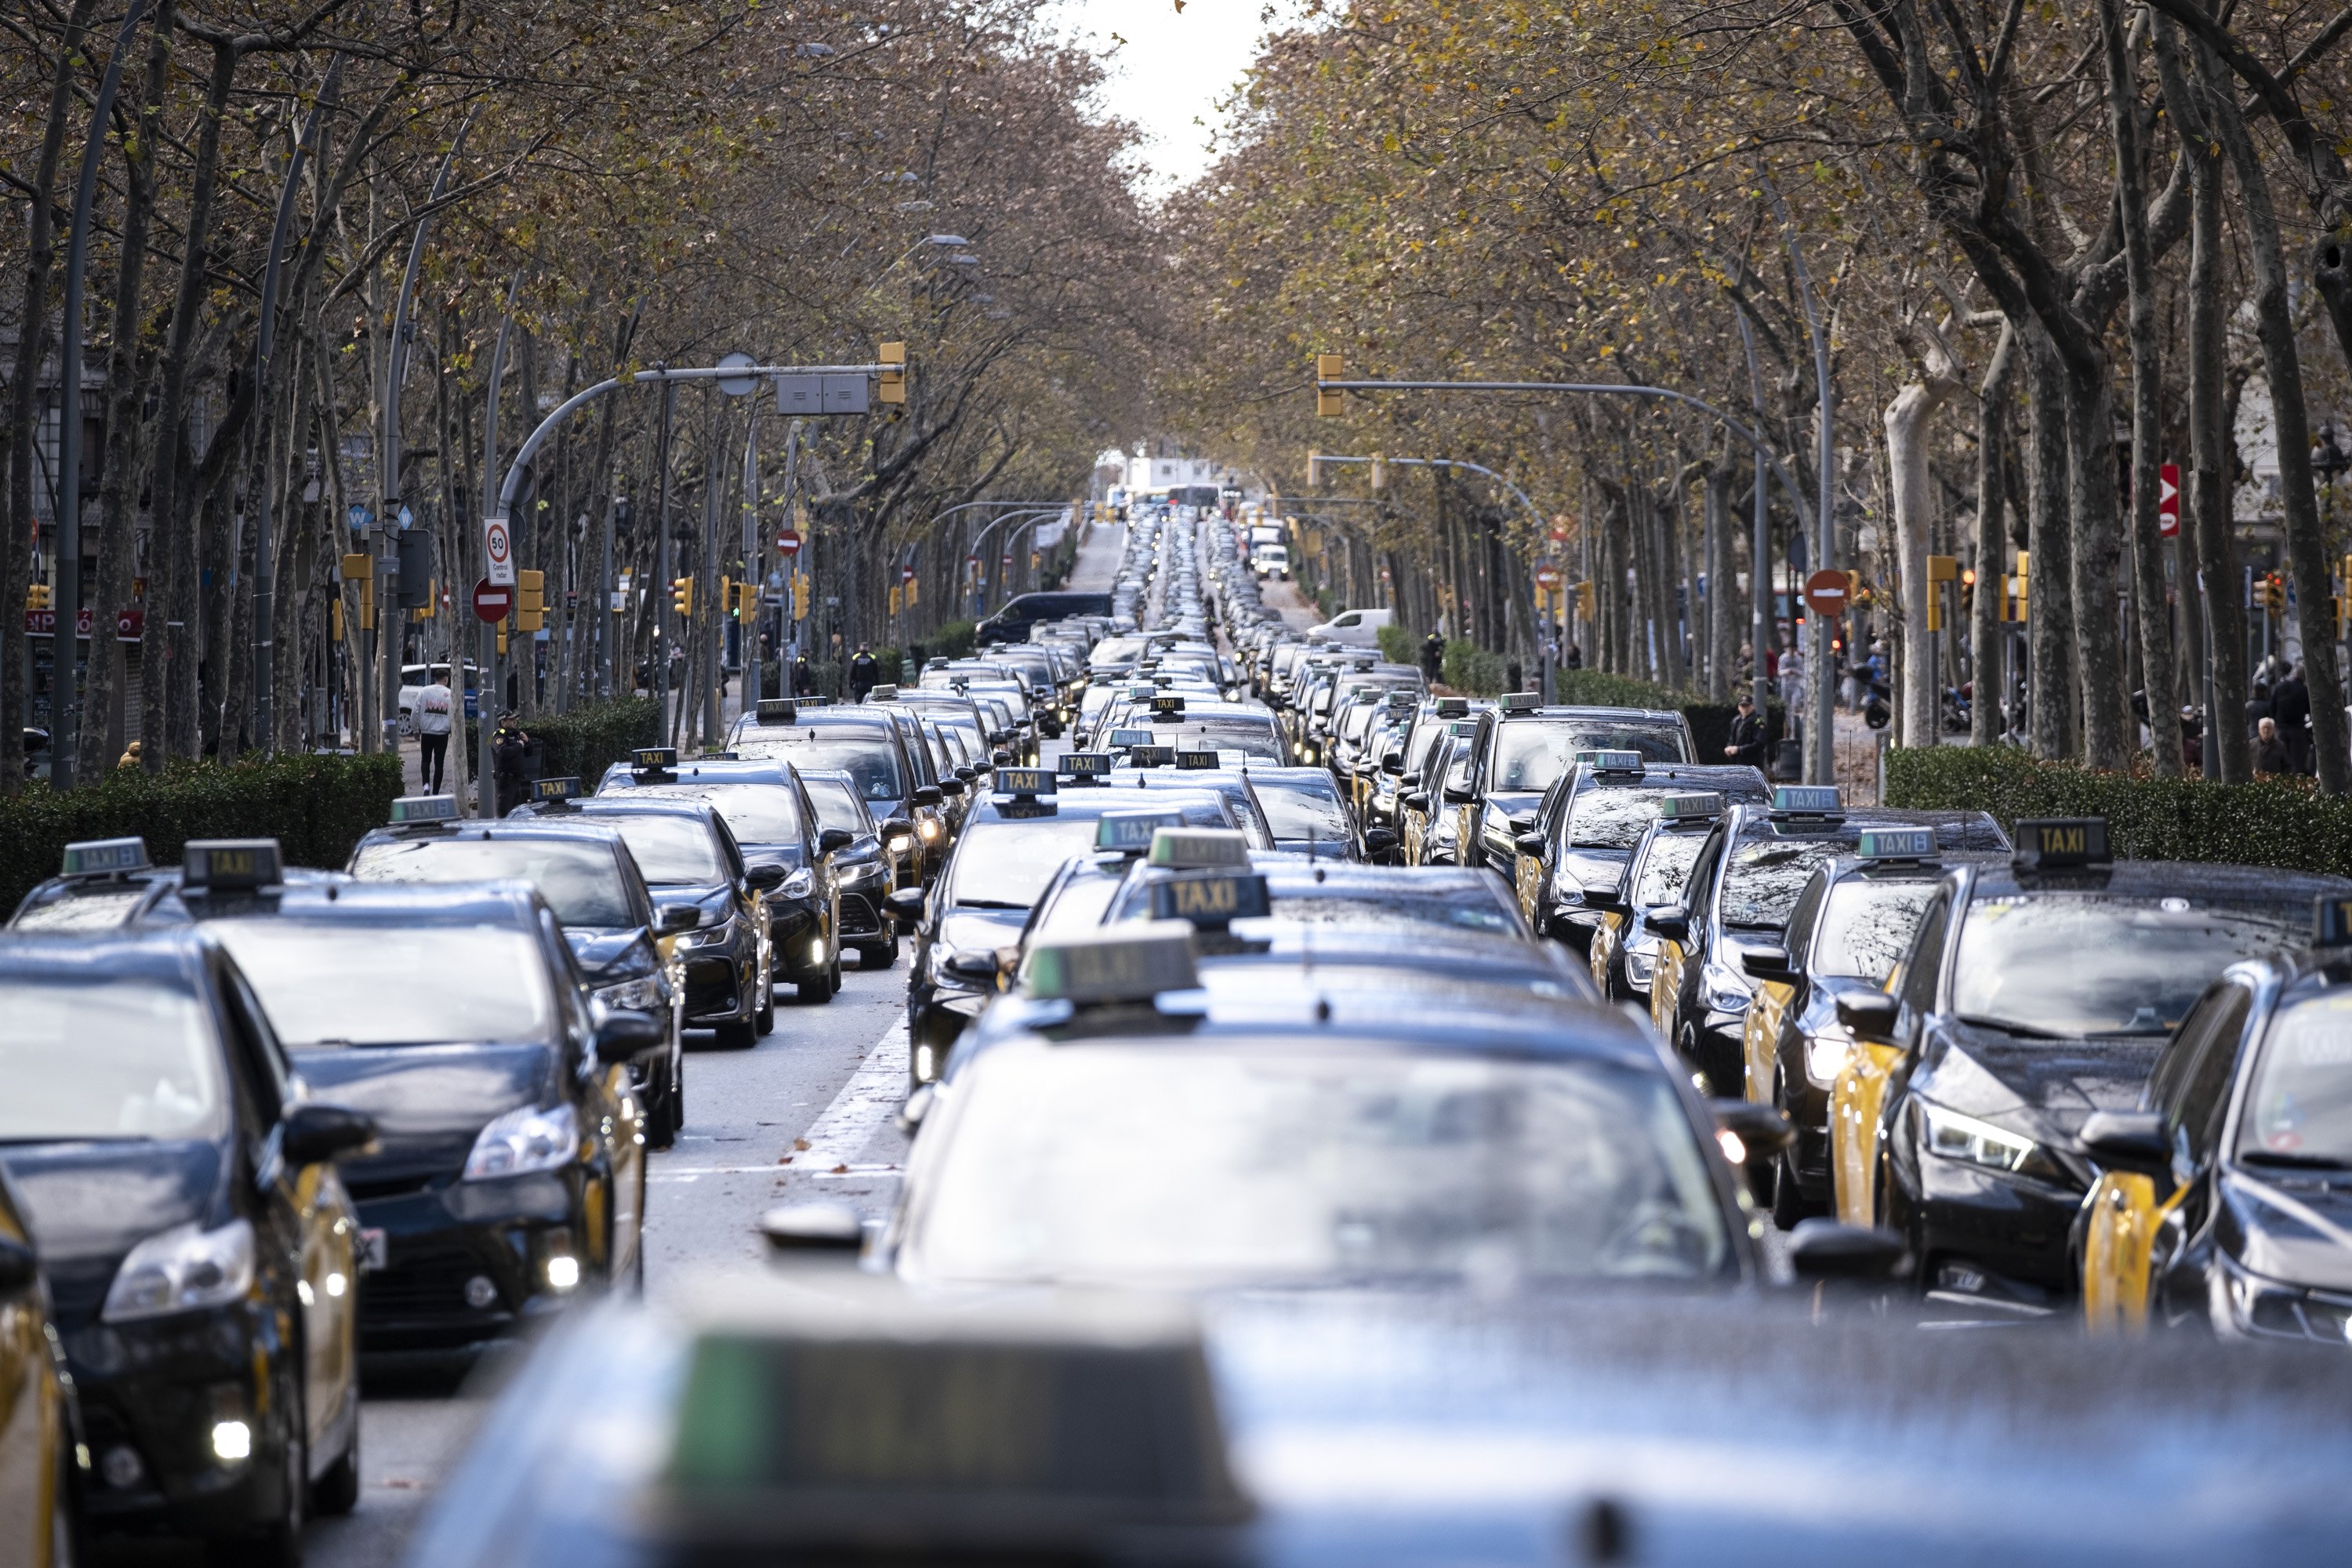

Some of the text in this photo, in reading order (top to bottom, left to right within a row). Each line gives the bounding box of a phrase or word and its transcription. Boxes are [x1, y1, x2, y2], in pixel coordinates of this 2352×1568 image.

[349, 512, 366, 524] W
[401, 513, 410, 524] W
[492, 537, 503, 550] 50
[1156, 699, 1174, 709] TAXI
[1511, 695, 1528, 706] TAXI
[764, 702, 783, 713] TAXI
[1459, 724, 1474, 734] TAXI
[641, 750, 664, 764] TAXI
[1188, 754, 1207, 767] TAXI
[1606, 754, 1627, 766] TAXI
[1069, 757, 1095, 771] TAXI
[1006, 772, 1038, 789] TAXI
[539, 782, 565, 796] TAXI
[1678, 797, 1703, 814] TAXI
[1790, 790, 1820, 808] TAXI
[1878, 833, 1912, 853] TAXI
[2042, 827, 2085, 853] TAXI
[1170, 879, 1238, 914] TAXI
